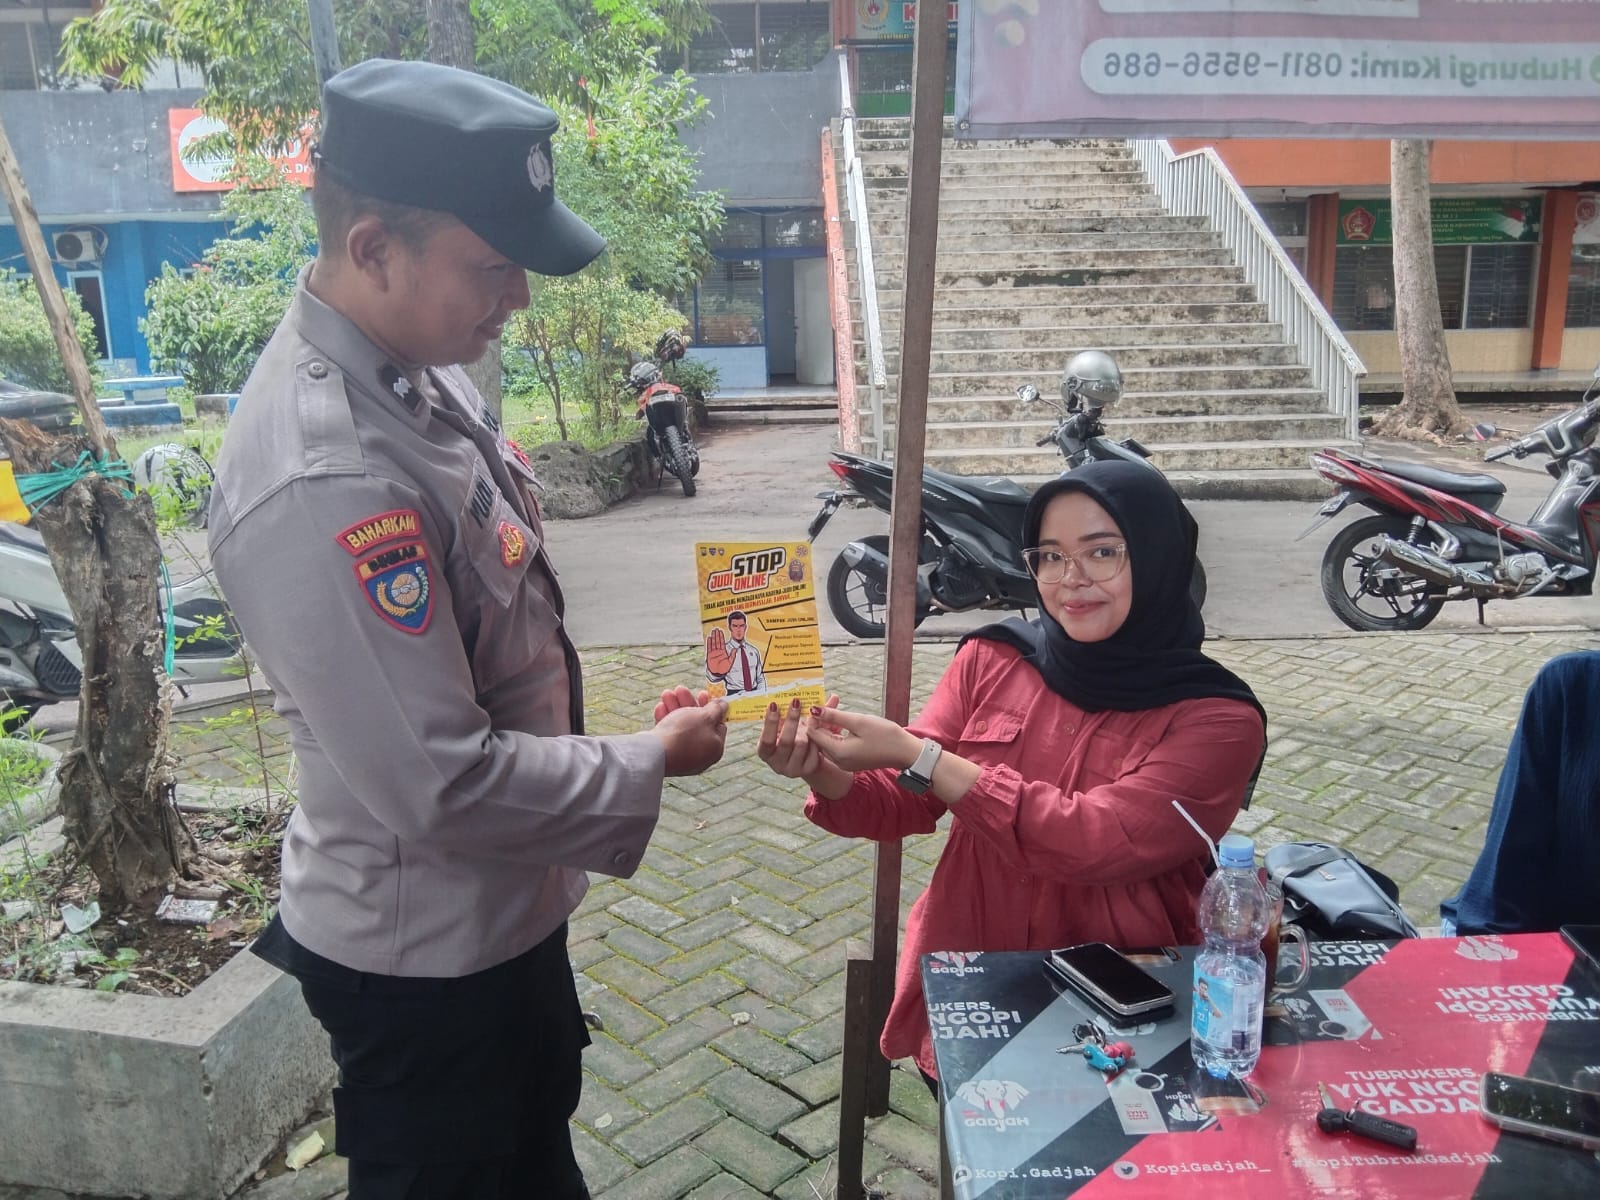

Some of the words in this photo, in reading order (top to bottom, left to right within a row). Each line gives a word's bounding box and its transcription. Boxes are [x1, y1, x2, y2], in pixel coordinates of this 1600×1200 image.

[346, 514, 415, 549] BAHARKAM
[734, 551, 782, 577] STOP
[710, 573, 733, 590] JUDI
[733, 573, 767, 591] ONLINE
[1281, 954, 1387, 967] ADJAH!
[1438, 984, 1575, 999] GADJAH!
[1436, 999, 1536, 1014] NGOPI
[929, 1011, 1022, 1025] NGOPI
[1468, 1011, 1600, 1023] TUBRUKERS,
[1329, 1082, 1406, 1099] YUK
[1408, 1081, 1481, 1096] NGO
[1359, 1098, 1481, 1115] GADJA
[974, 1166, 1097, 1181] Kopi.Gadjah
[1144, 1160, 1272, 1176] KopiGadjah_
